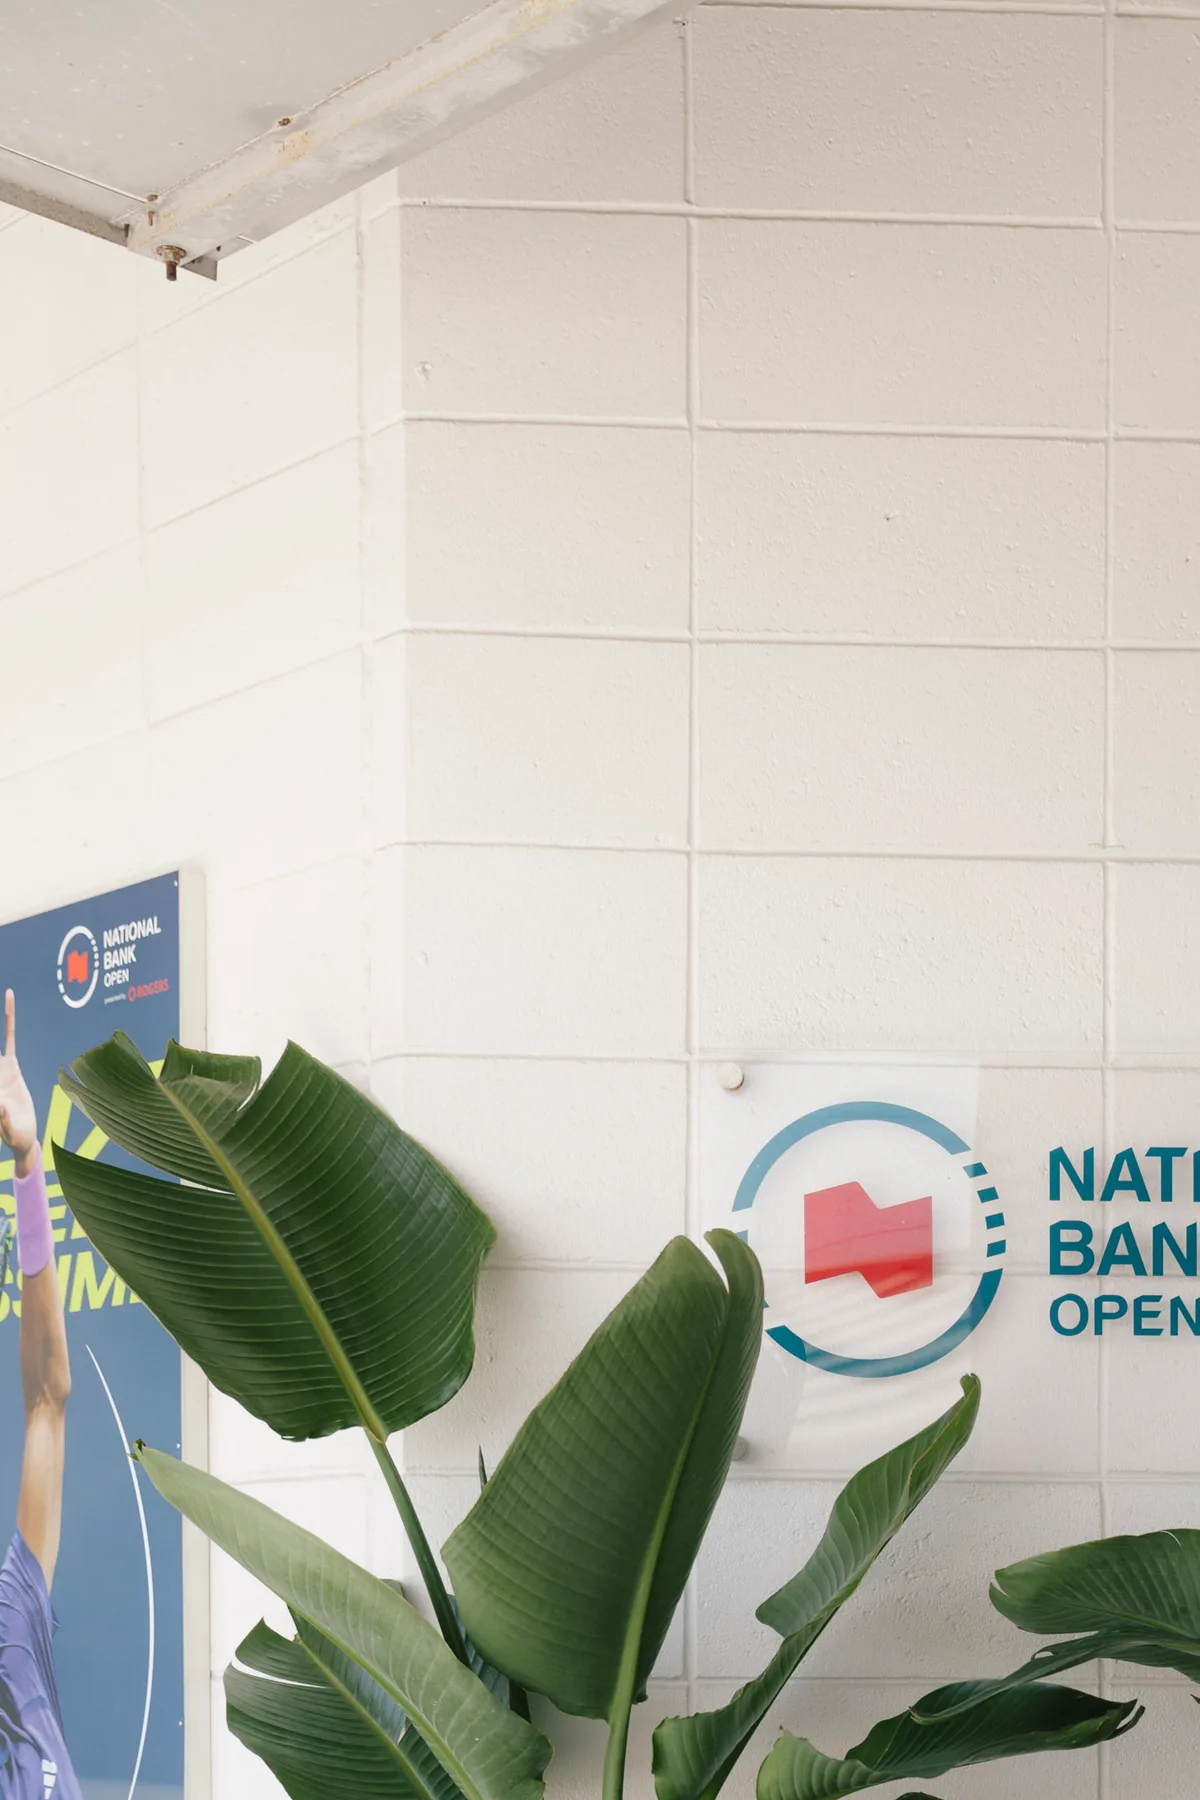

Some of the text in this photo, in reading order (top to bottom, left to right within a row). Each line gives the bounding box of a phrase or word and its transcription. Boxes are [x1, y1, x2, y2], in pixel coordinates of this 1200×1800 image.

[103, 916, 161, 949] NATIONAL
[103, 944, 137, 970] BANK
[103, 968, 130, 988] OPEN
